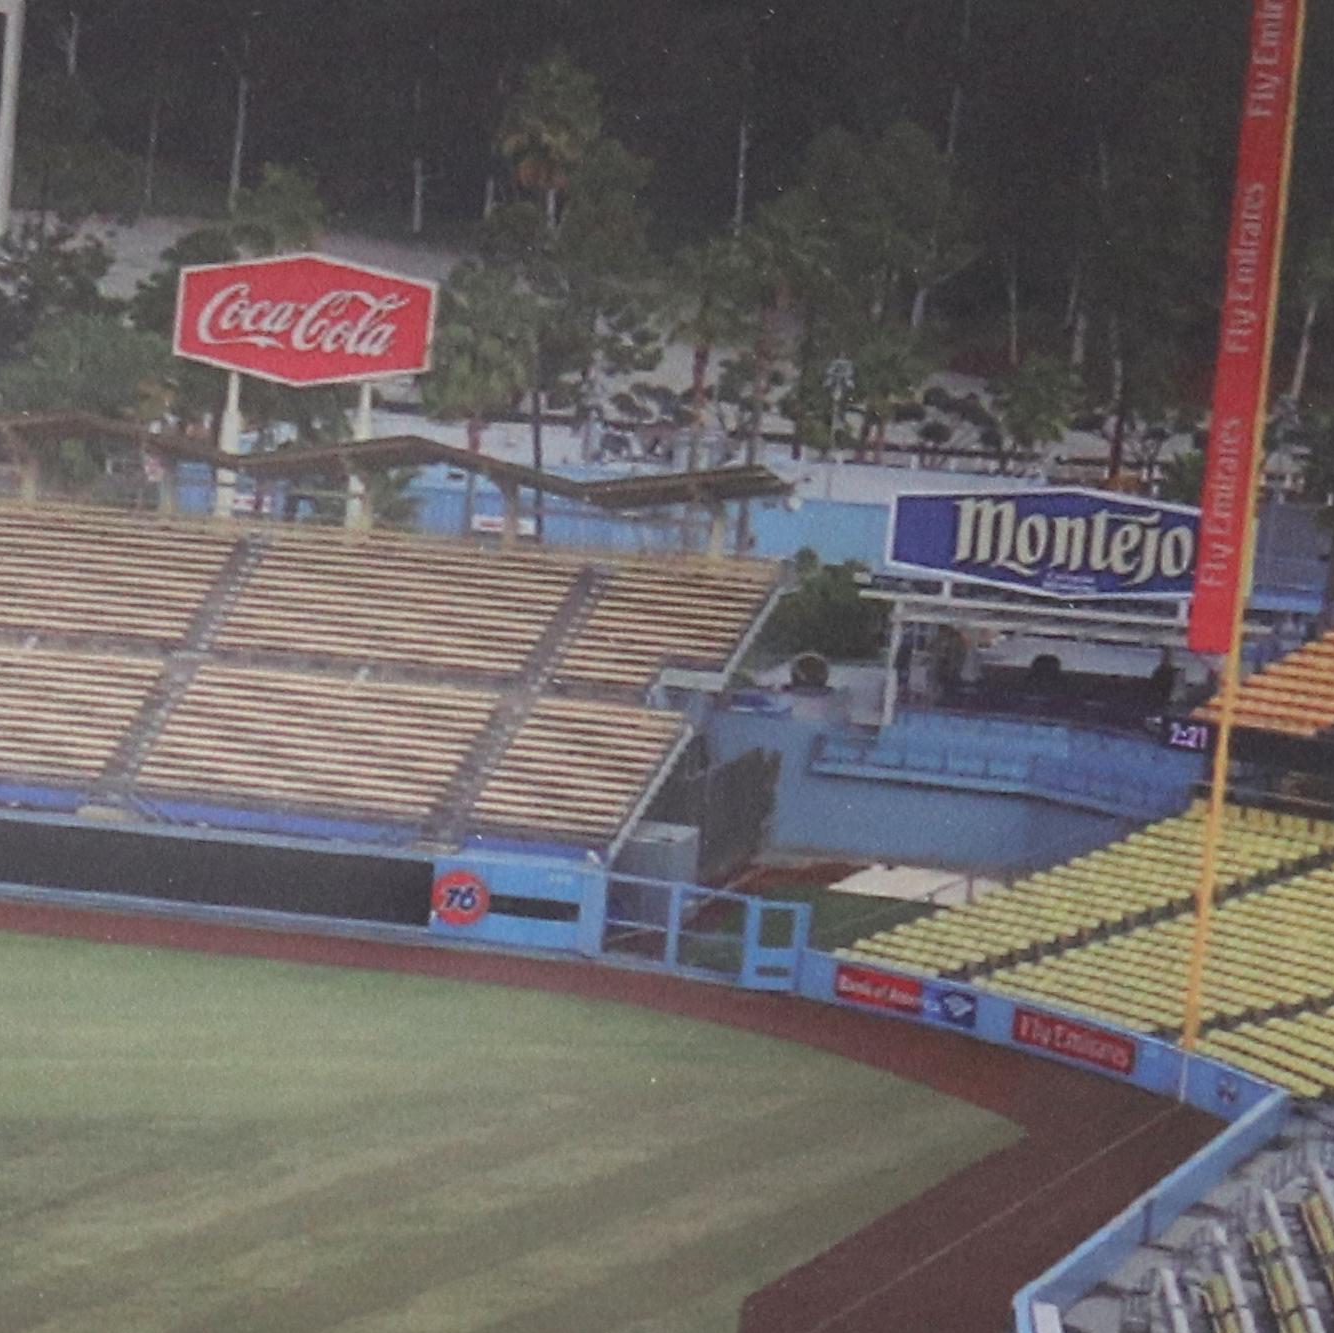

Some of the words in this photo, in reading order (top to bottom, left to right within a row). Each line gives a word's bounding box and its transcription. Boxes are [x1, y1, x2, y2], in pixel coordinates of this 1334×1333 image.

[1244, 72, 1283, 117] Fly
[1228, 182, 1267, 301] Emirates
[197, 282, 411, 357] Coca-Cola
[1223, 307, 1260, 353] Fly
[1204, 416, 1244, 535] Emirates
[952, 498, 1195, 587] Montejo
[1197, 541, 1235, 587] Fly
[444, 884, 478, 910] 76
